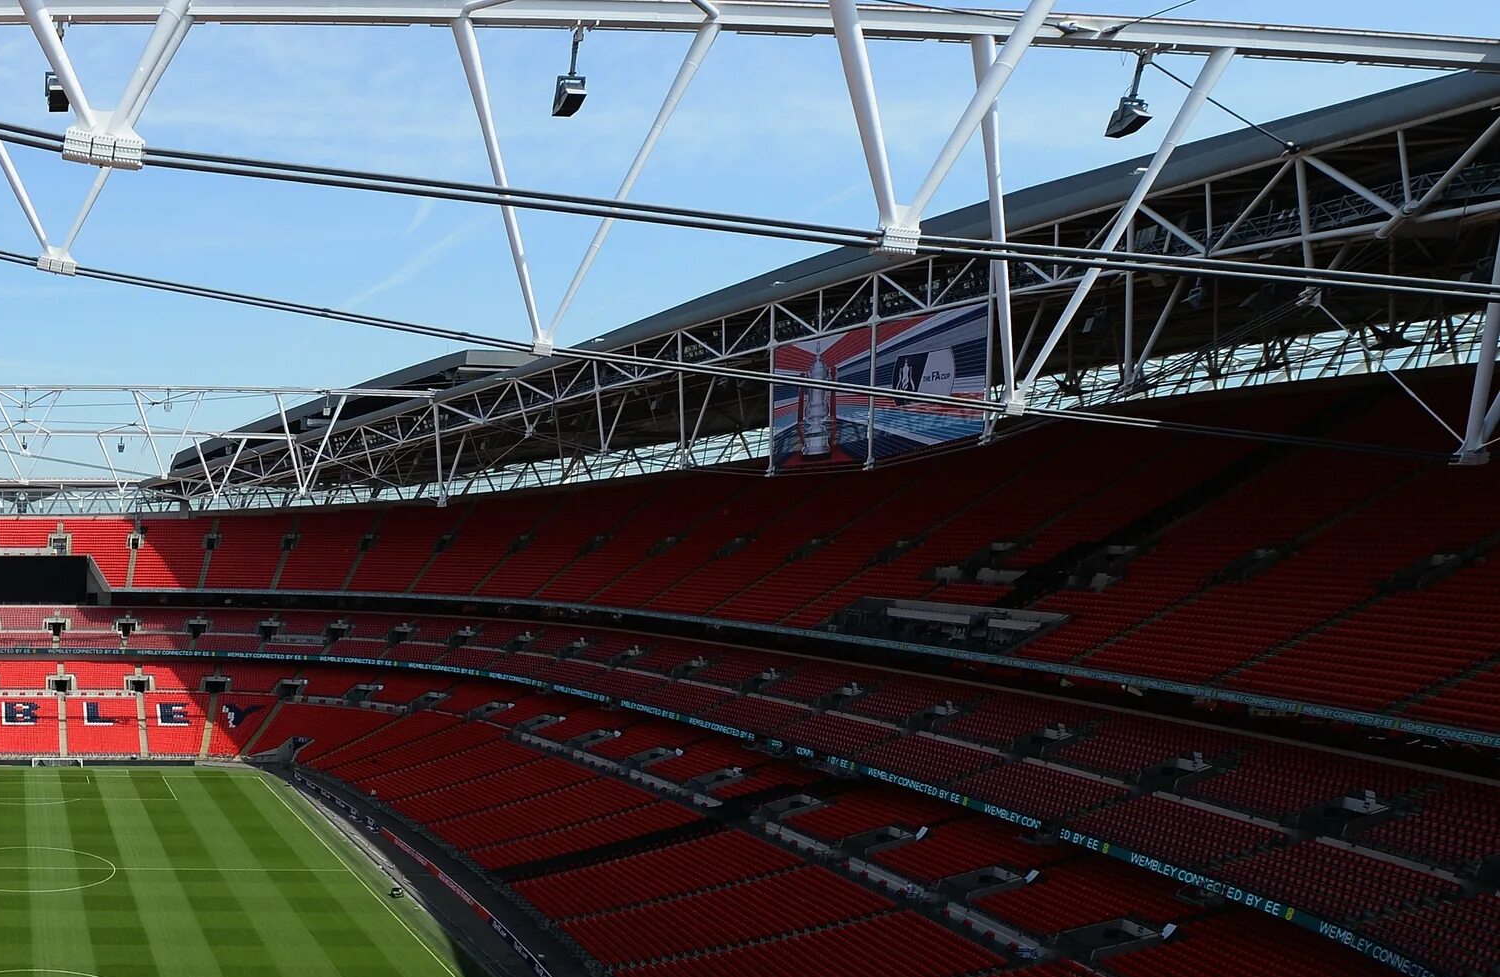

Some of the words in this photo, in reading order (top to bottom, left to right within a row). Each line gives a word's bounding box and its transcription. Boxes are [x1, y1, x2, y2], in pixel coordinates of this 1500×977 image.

[932, 371, 940, 381] FA
[941, 372, 951, 380] CUP
[868, 768, 898, 786] WEMBLEY
[898, 777, 938, 796] CONNECTED
[939, 790, 949, 800] BY
[950, 792, 960, 804] EE
[984, 803, 1021, 824] WEMBLEY
[1072, 832, 1086, 844] BY
[1087, 838, 1099, 850] EE
[1130, 852, 1178, 878] WEMBLEY
[1245, 893, 1262, 908] BY
[1264, 901, 1281, 916] EE
[1320, 920, 1372, 954] WEMBLEY
